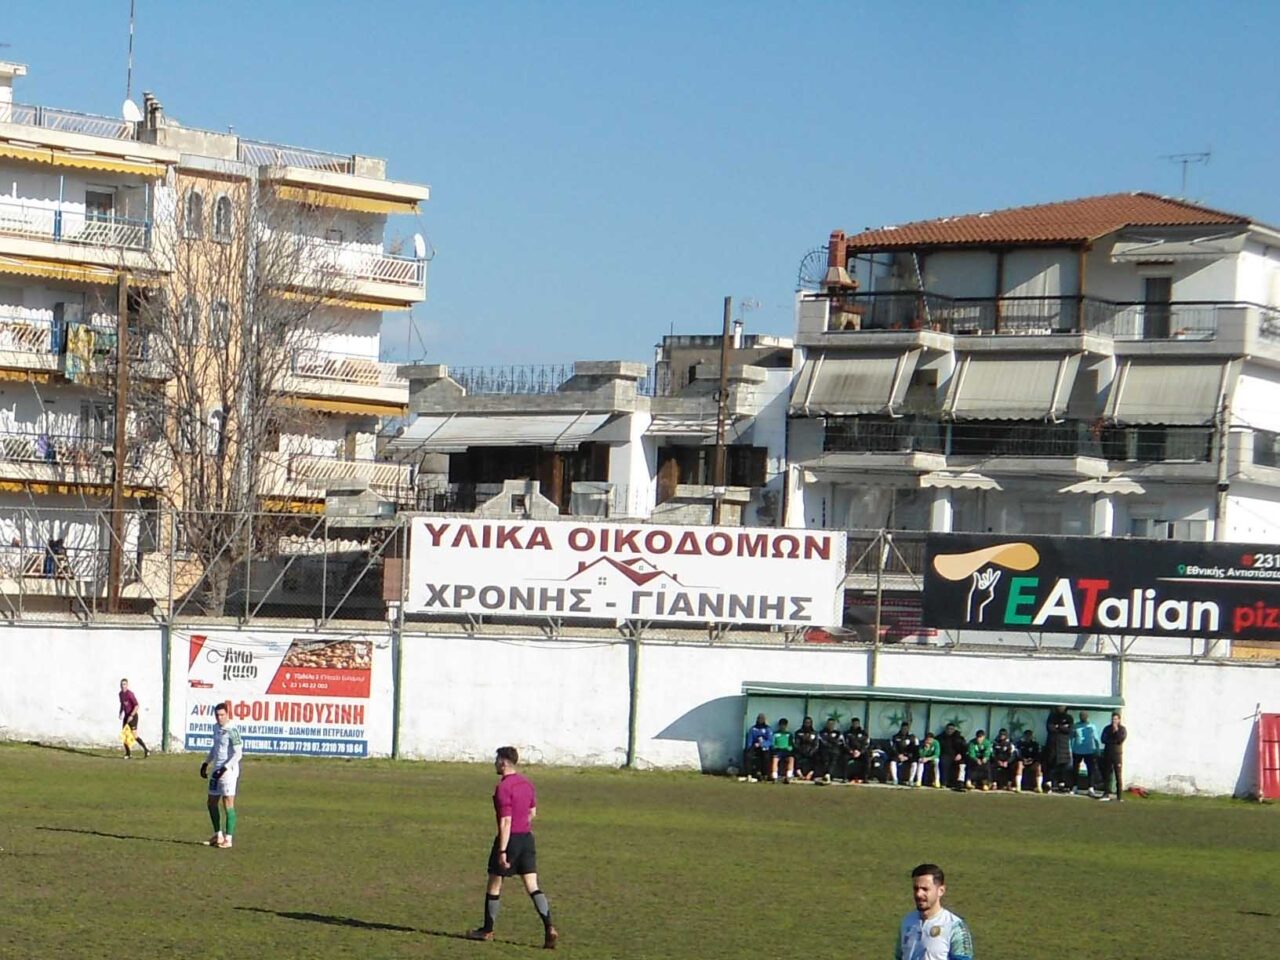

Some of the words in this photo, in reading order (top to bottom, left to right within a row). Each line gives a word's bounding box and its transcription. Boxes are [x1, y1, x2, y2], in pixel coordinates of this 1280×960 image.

[424, 523, 553, 551] ΥΛΙΚΑ
[567, 529, 832, 560] ΟΙΚΟΔΟΜΩΝ
[424, 583, 593, 613] ΧΡΟΝΗΣ
[631, 591, 812, 622] ΓΙΑΝΝΗΣ
[1003, 578, 1219, 632] EATalian
[248, 725, 283, 735] ΚΑΥΣΙΜΩΝ
[289, 726, 322, 737] ΔΙΑΝΟΜΗ
[322, 728, 365, 738] ΠΕΤΡΕΛΑΙΟΥ
[274, 701, 365, 726] ΜΠΟΥΣΙΝΗ
